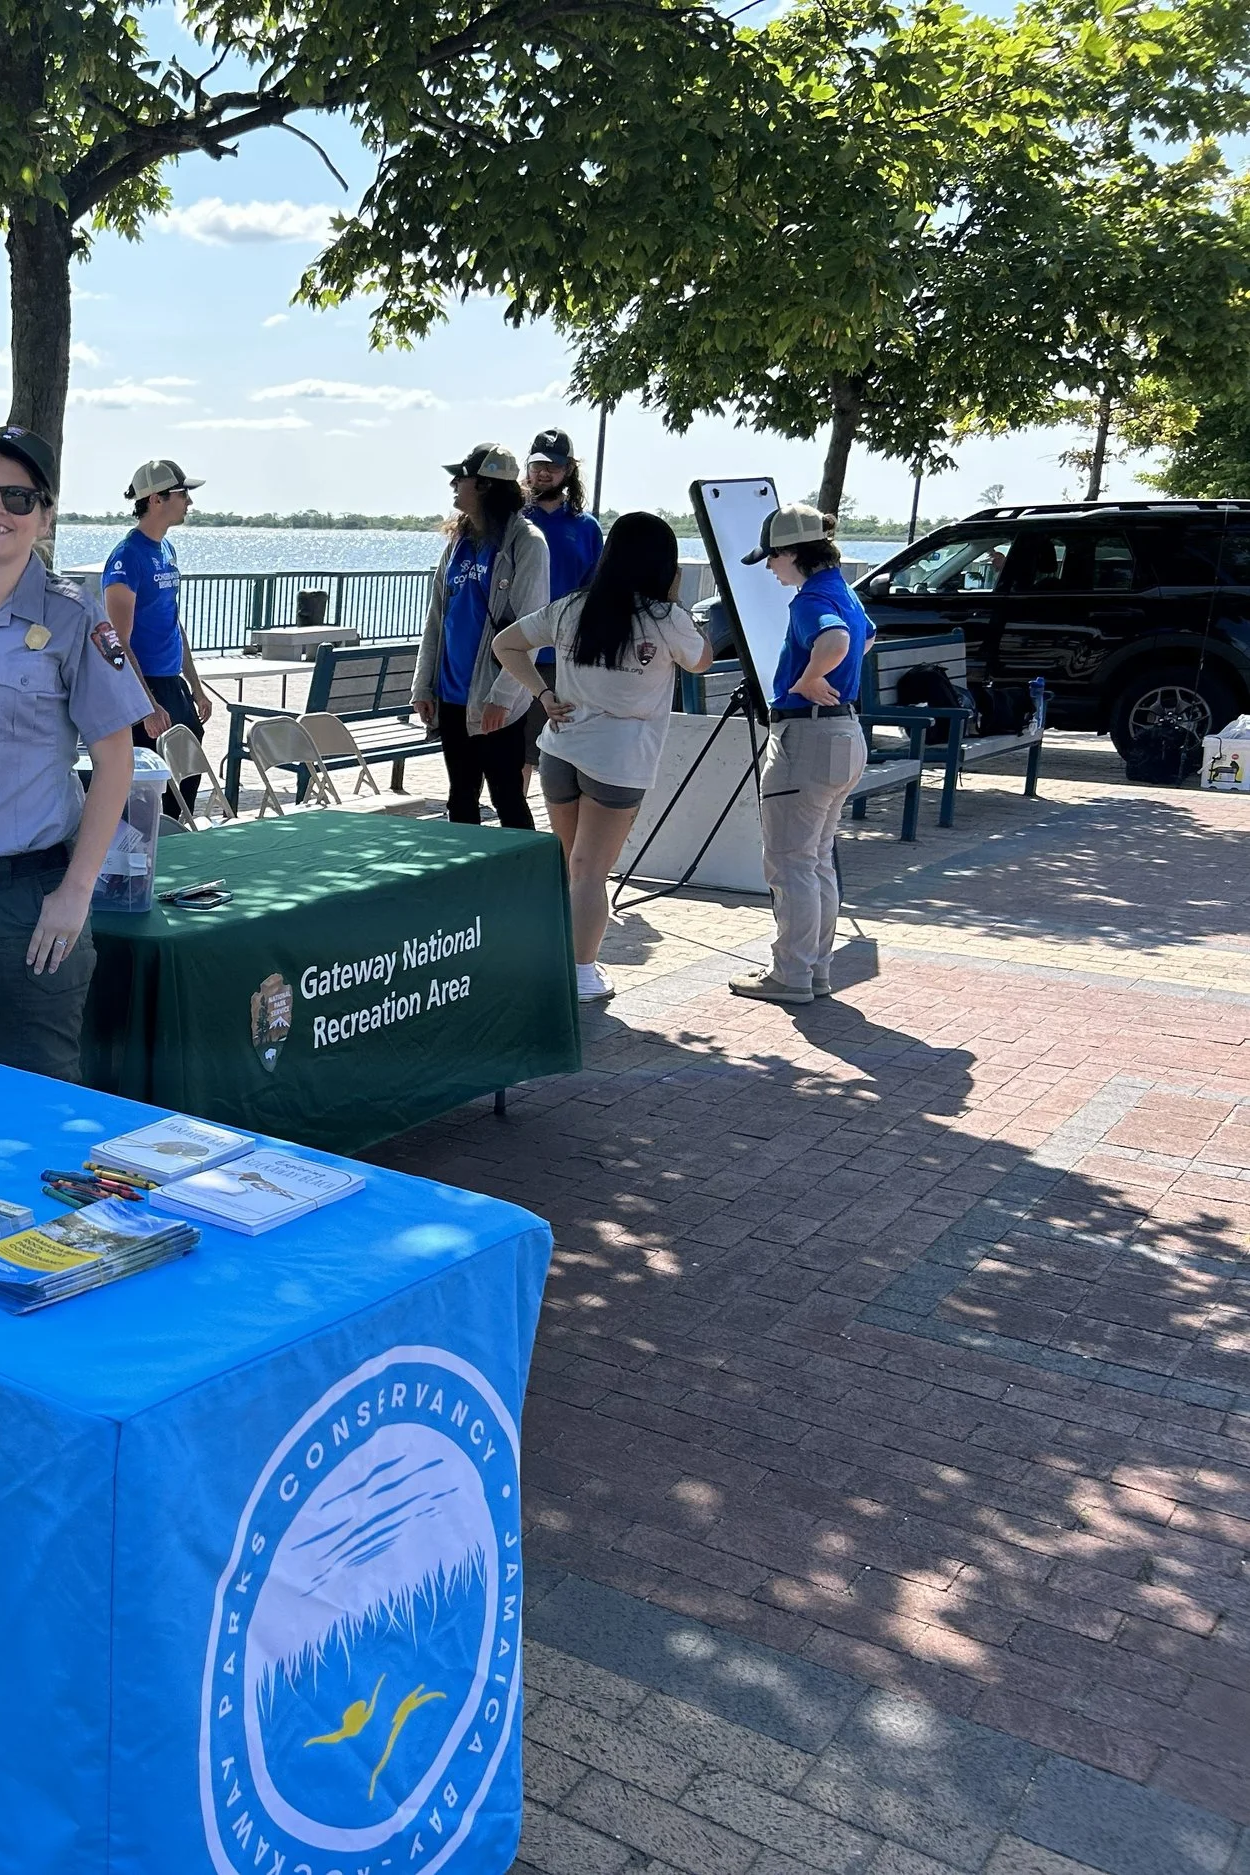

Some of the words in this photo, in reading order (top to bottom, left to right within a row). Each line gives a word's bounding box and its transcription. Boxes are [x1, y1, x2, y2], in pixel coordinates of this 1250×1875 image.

[300, 951, 396, 999] Gateway
[403, 916, 481, 970] National
[314, 992, 420, 1048] Recreation
[427, 975, 471, 1010] Area
[217, 1531, 267, 1719] PARKS
[278, 1381, 497, 1503] CONSERVANCY
[466, 1531, 519, 1755] JAMAICA
